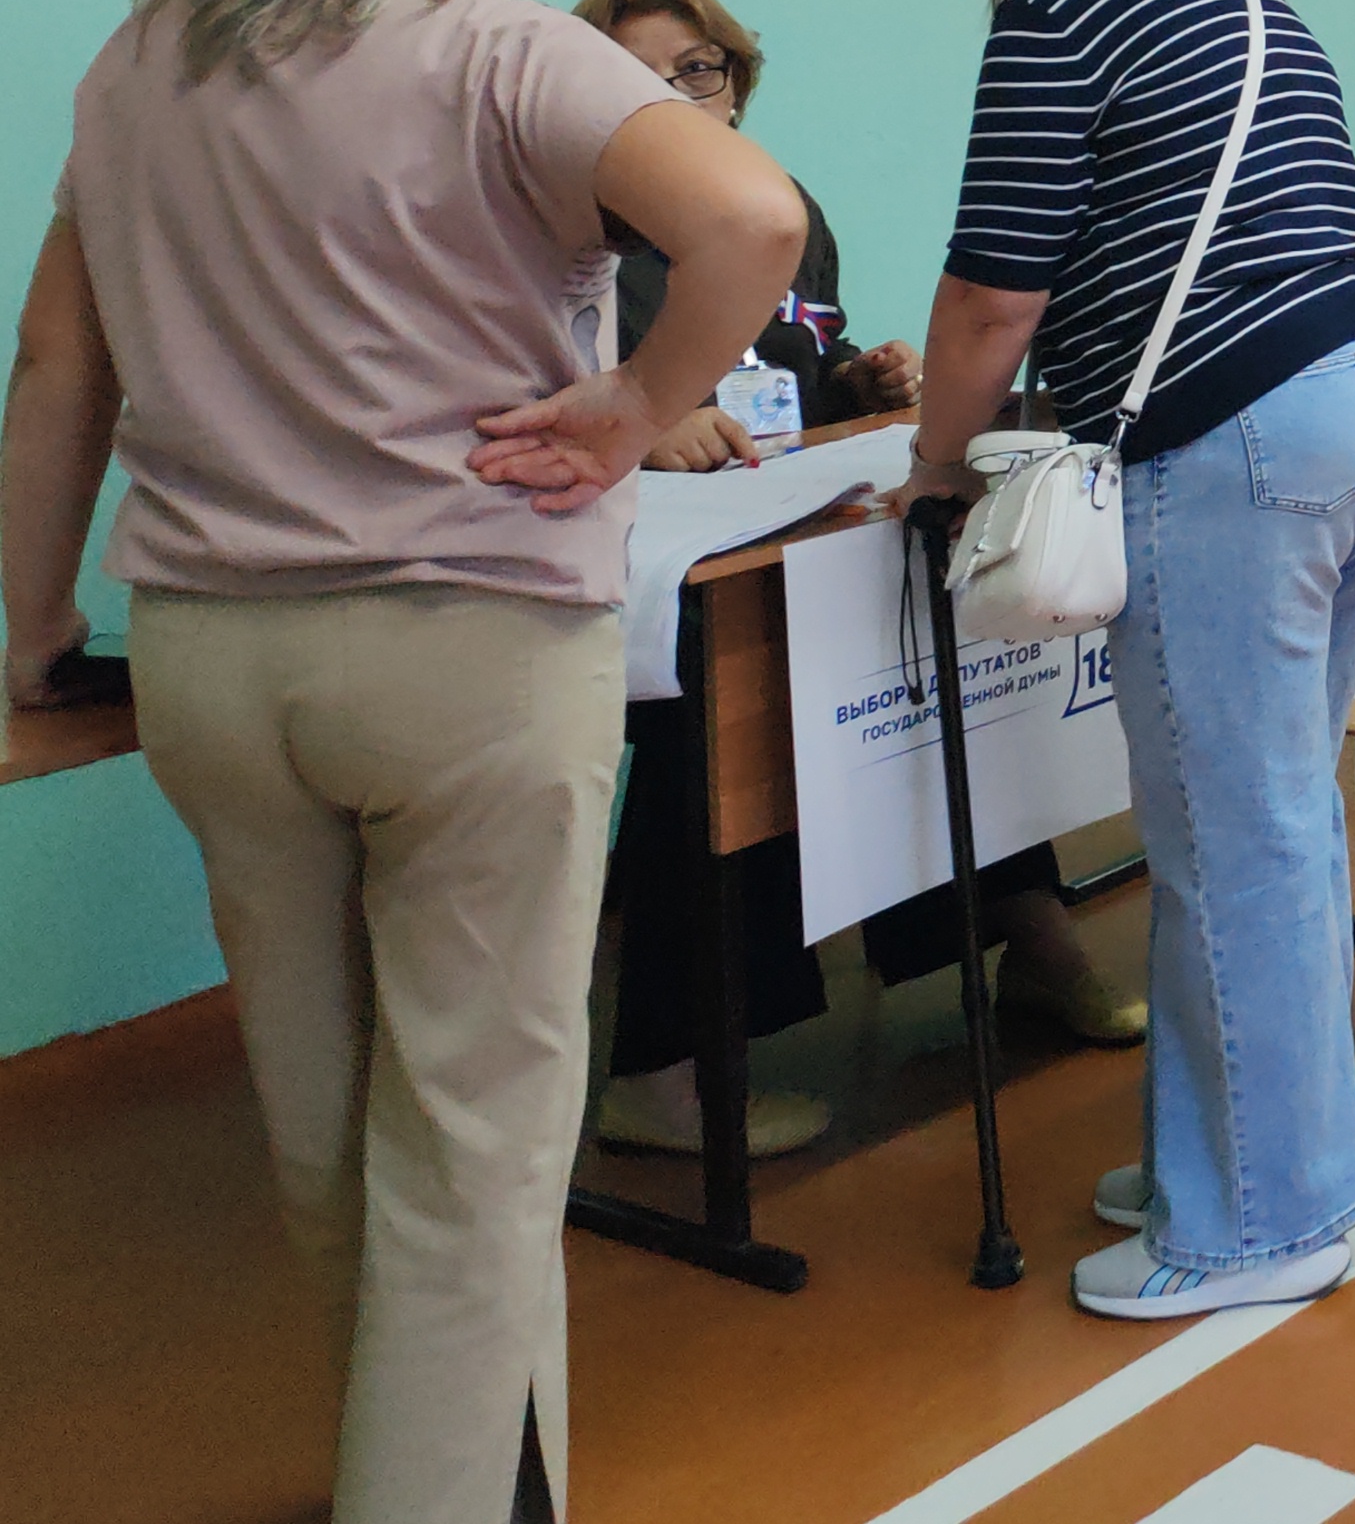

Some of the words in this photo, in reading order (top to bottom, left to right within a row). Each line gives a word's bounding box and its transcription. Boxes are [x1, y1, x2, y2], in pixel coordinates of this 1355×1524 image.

[836, 684, 912, 725] ВЫБОР
[928, 642, 1042, 698] ДПУТАТОВ
[861, 676, 1015, 745] ГОСУДАРСЕННОЙ
[1017, 663, 1061, 694] ДУМЫ
